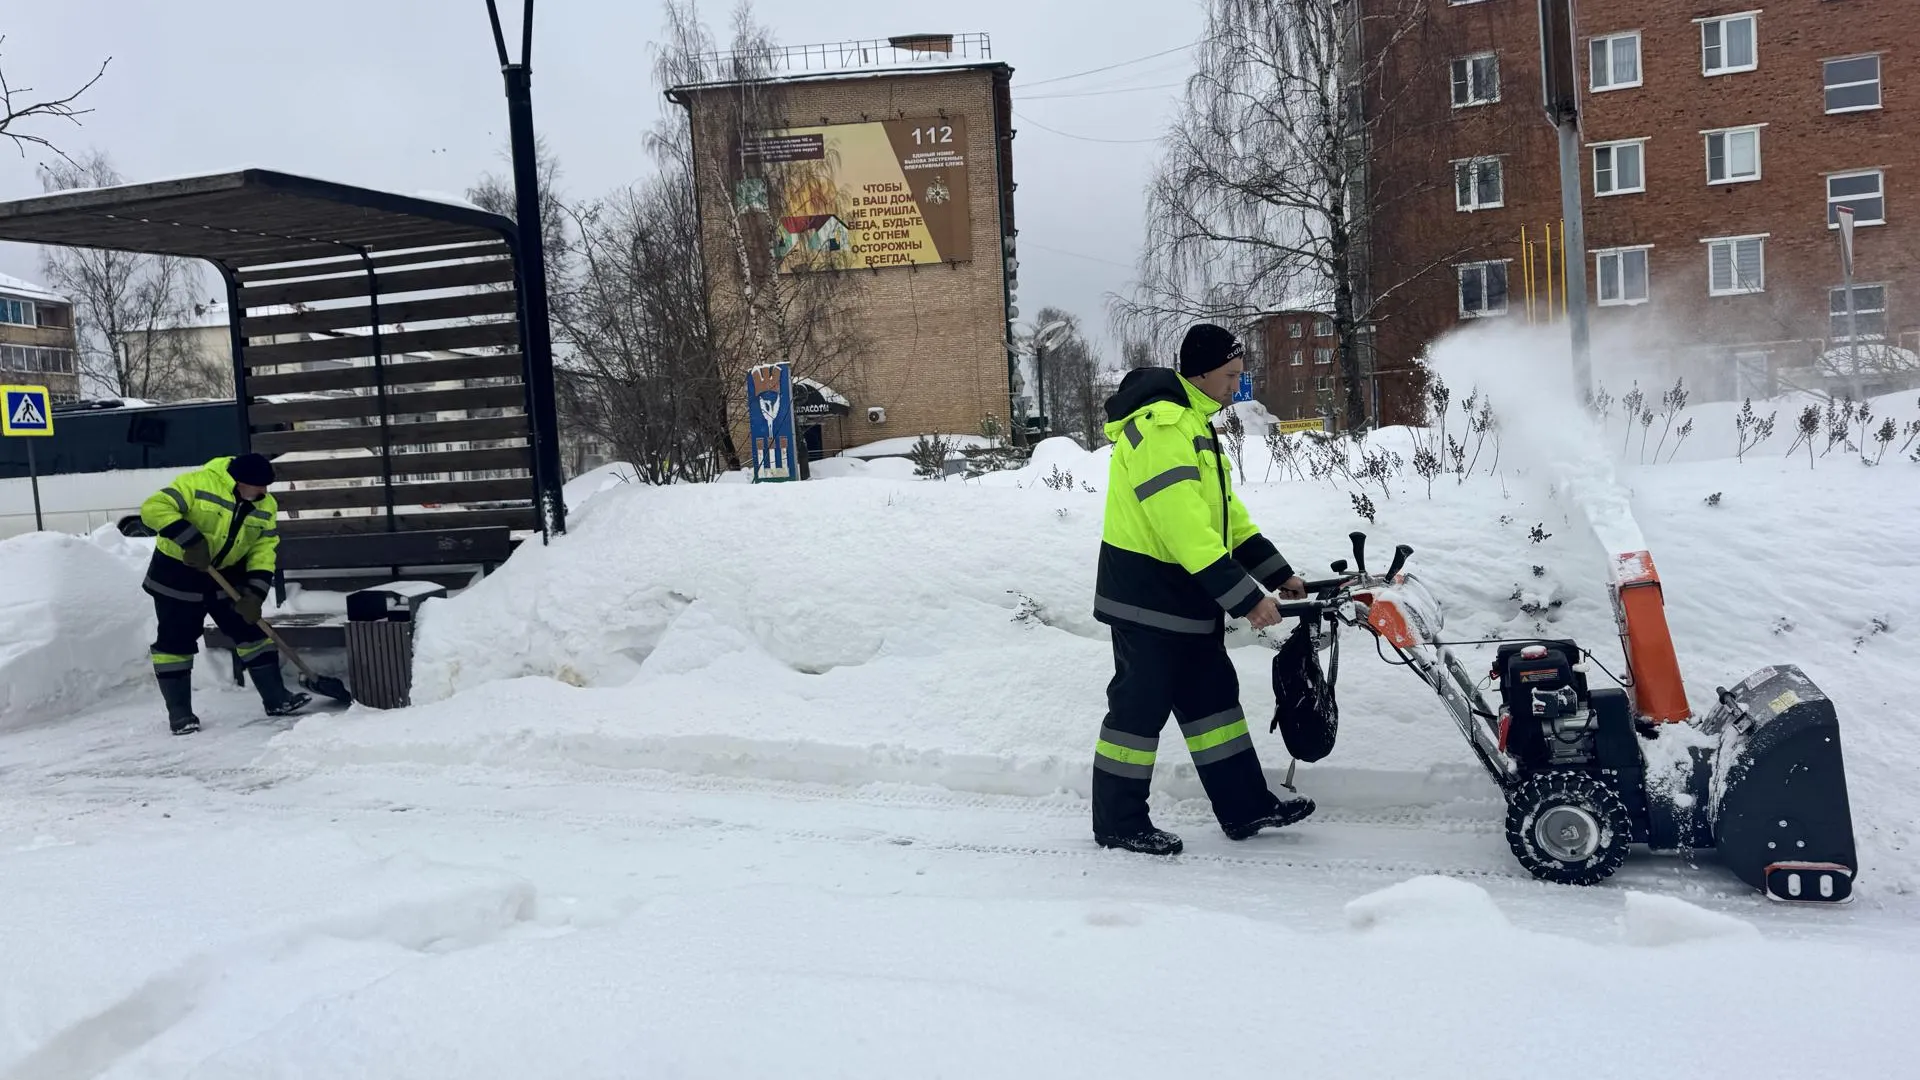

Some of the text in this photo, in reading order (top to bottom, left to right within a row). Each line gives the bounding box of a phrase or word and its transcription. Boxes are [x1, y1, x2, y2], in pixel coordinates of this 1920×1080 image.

[911, 125, 953, 145] 112
[863, 182, 902, 193] ЧТОБЫ
[852, 193, 916, 206] В ВАШ ДОМ
[852, 205, 916, 218] НЕ ПРИШЛА
[848, 217, 923, 231] БЕДА, БУДЬТЕ
[862, 229, 910, 241] С ОГНЕМ
[851, 240, 922, 254] ОСТОРОЖНЫ
[865, 253, 910, 265] ВСЕГДА!
